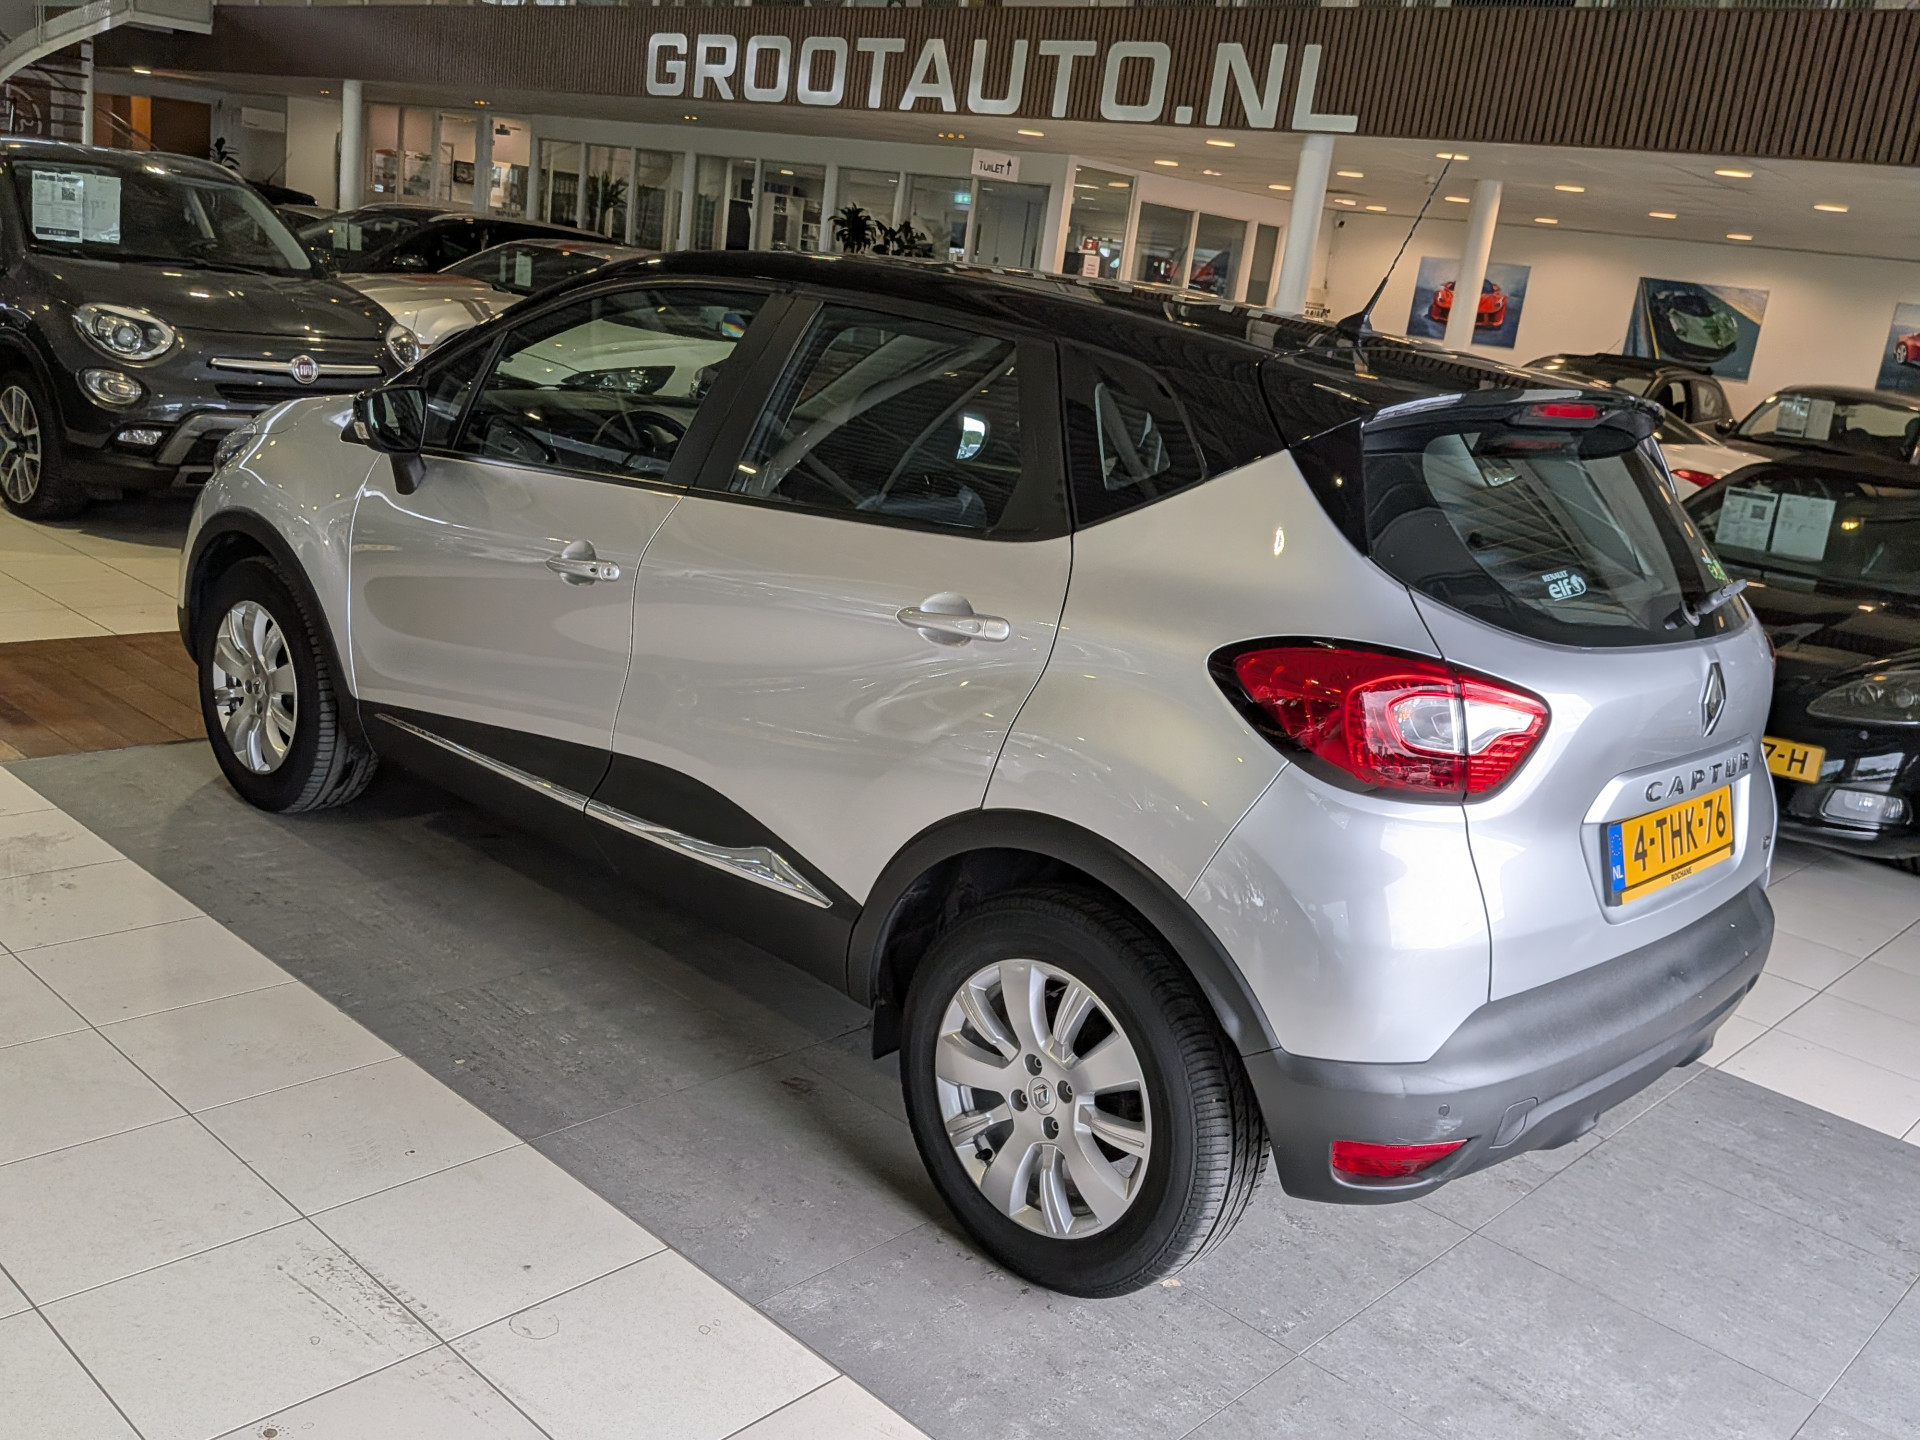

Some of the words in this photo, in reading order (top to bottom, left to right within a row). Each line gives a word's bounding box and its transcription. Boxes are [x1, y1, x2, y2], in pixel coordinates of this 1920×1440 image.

[646, 32, 1359, 133] GROOTAUTO.NL
[1541, 570, 1569, 583] RENAULT
[1548, 578, 1573, 599] elf
[1645, 752, 1750, 803] CAPTUR
[1633, 795, 1727, 872] 4-THK-76
[1612, 865, 1624, 881] NL
